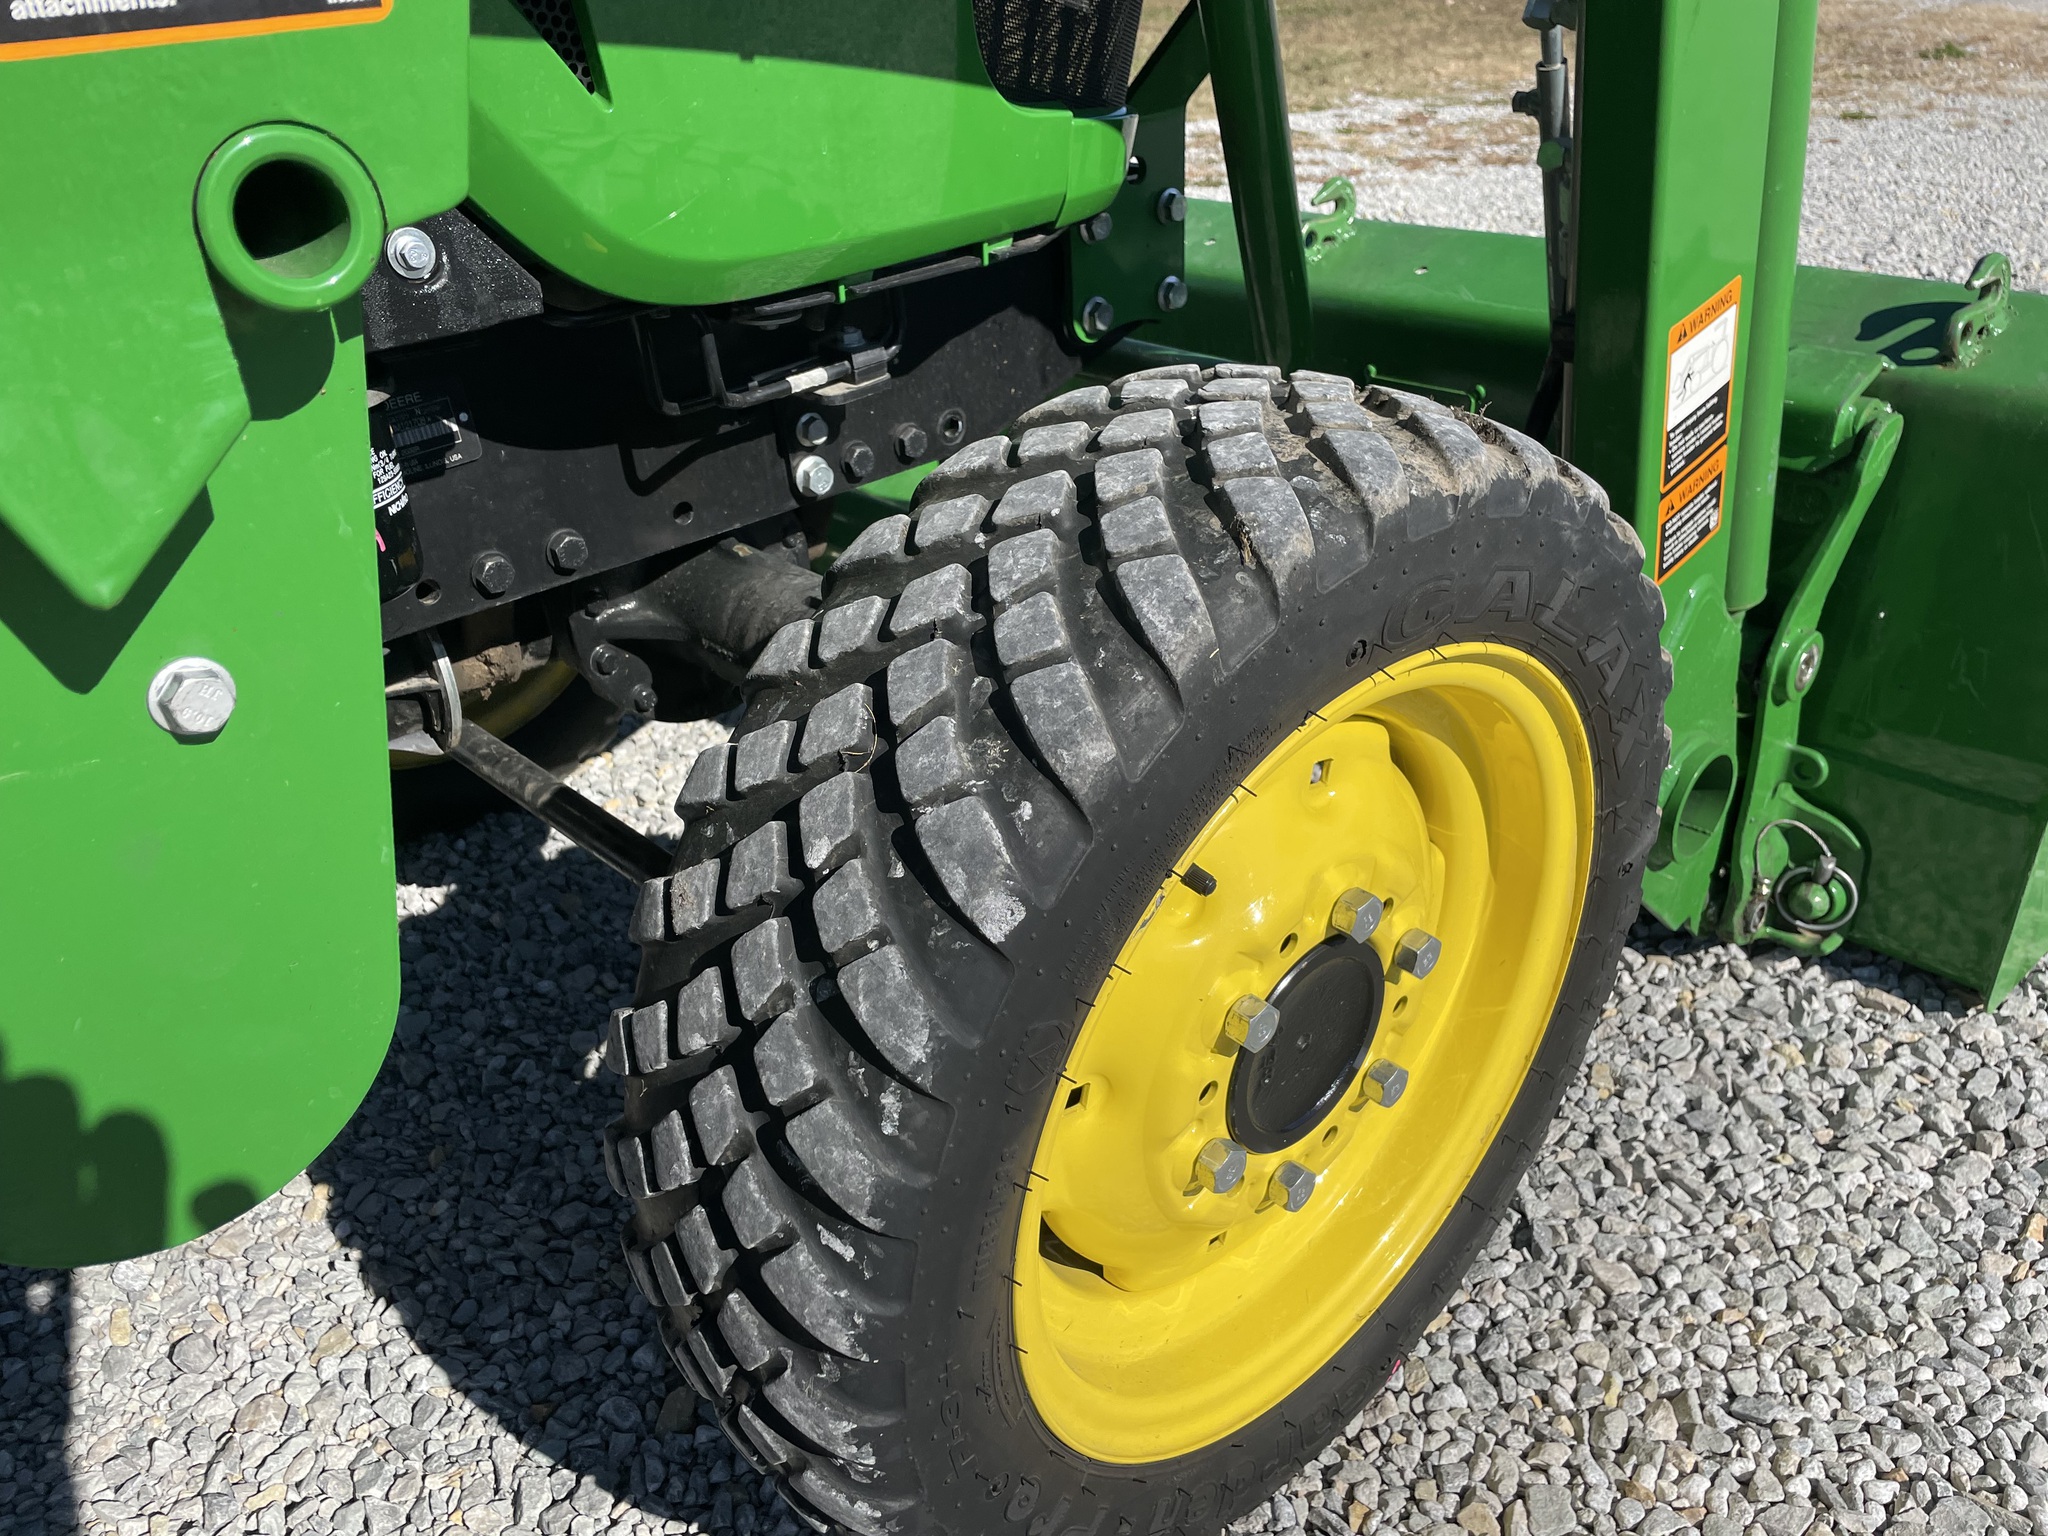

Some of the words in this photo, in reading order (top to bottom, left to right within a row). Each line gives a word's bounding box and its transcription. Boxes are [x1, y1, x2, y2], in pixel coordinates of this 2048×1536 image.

[1689, 289, 1733, 334] WARNING
[372, 467, 385, 480] FOR
[449, 452, 463, 463] USA
[1677, 457, 1720, 506] WARNING
[1381, 564, 1657, 836] GALAXY
